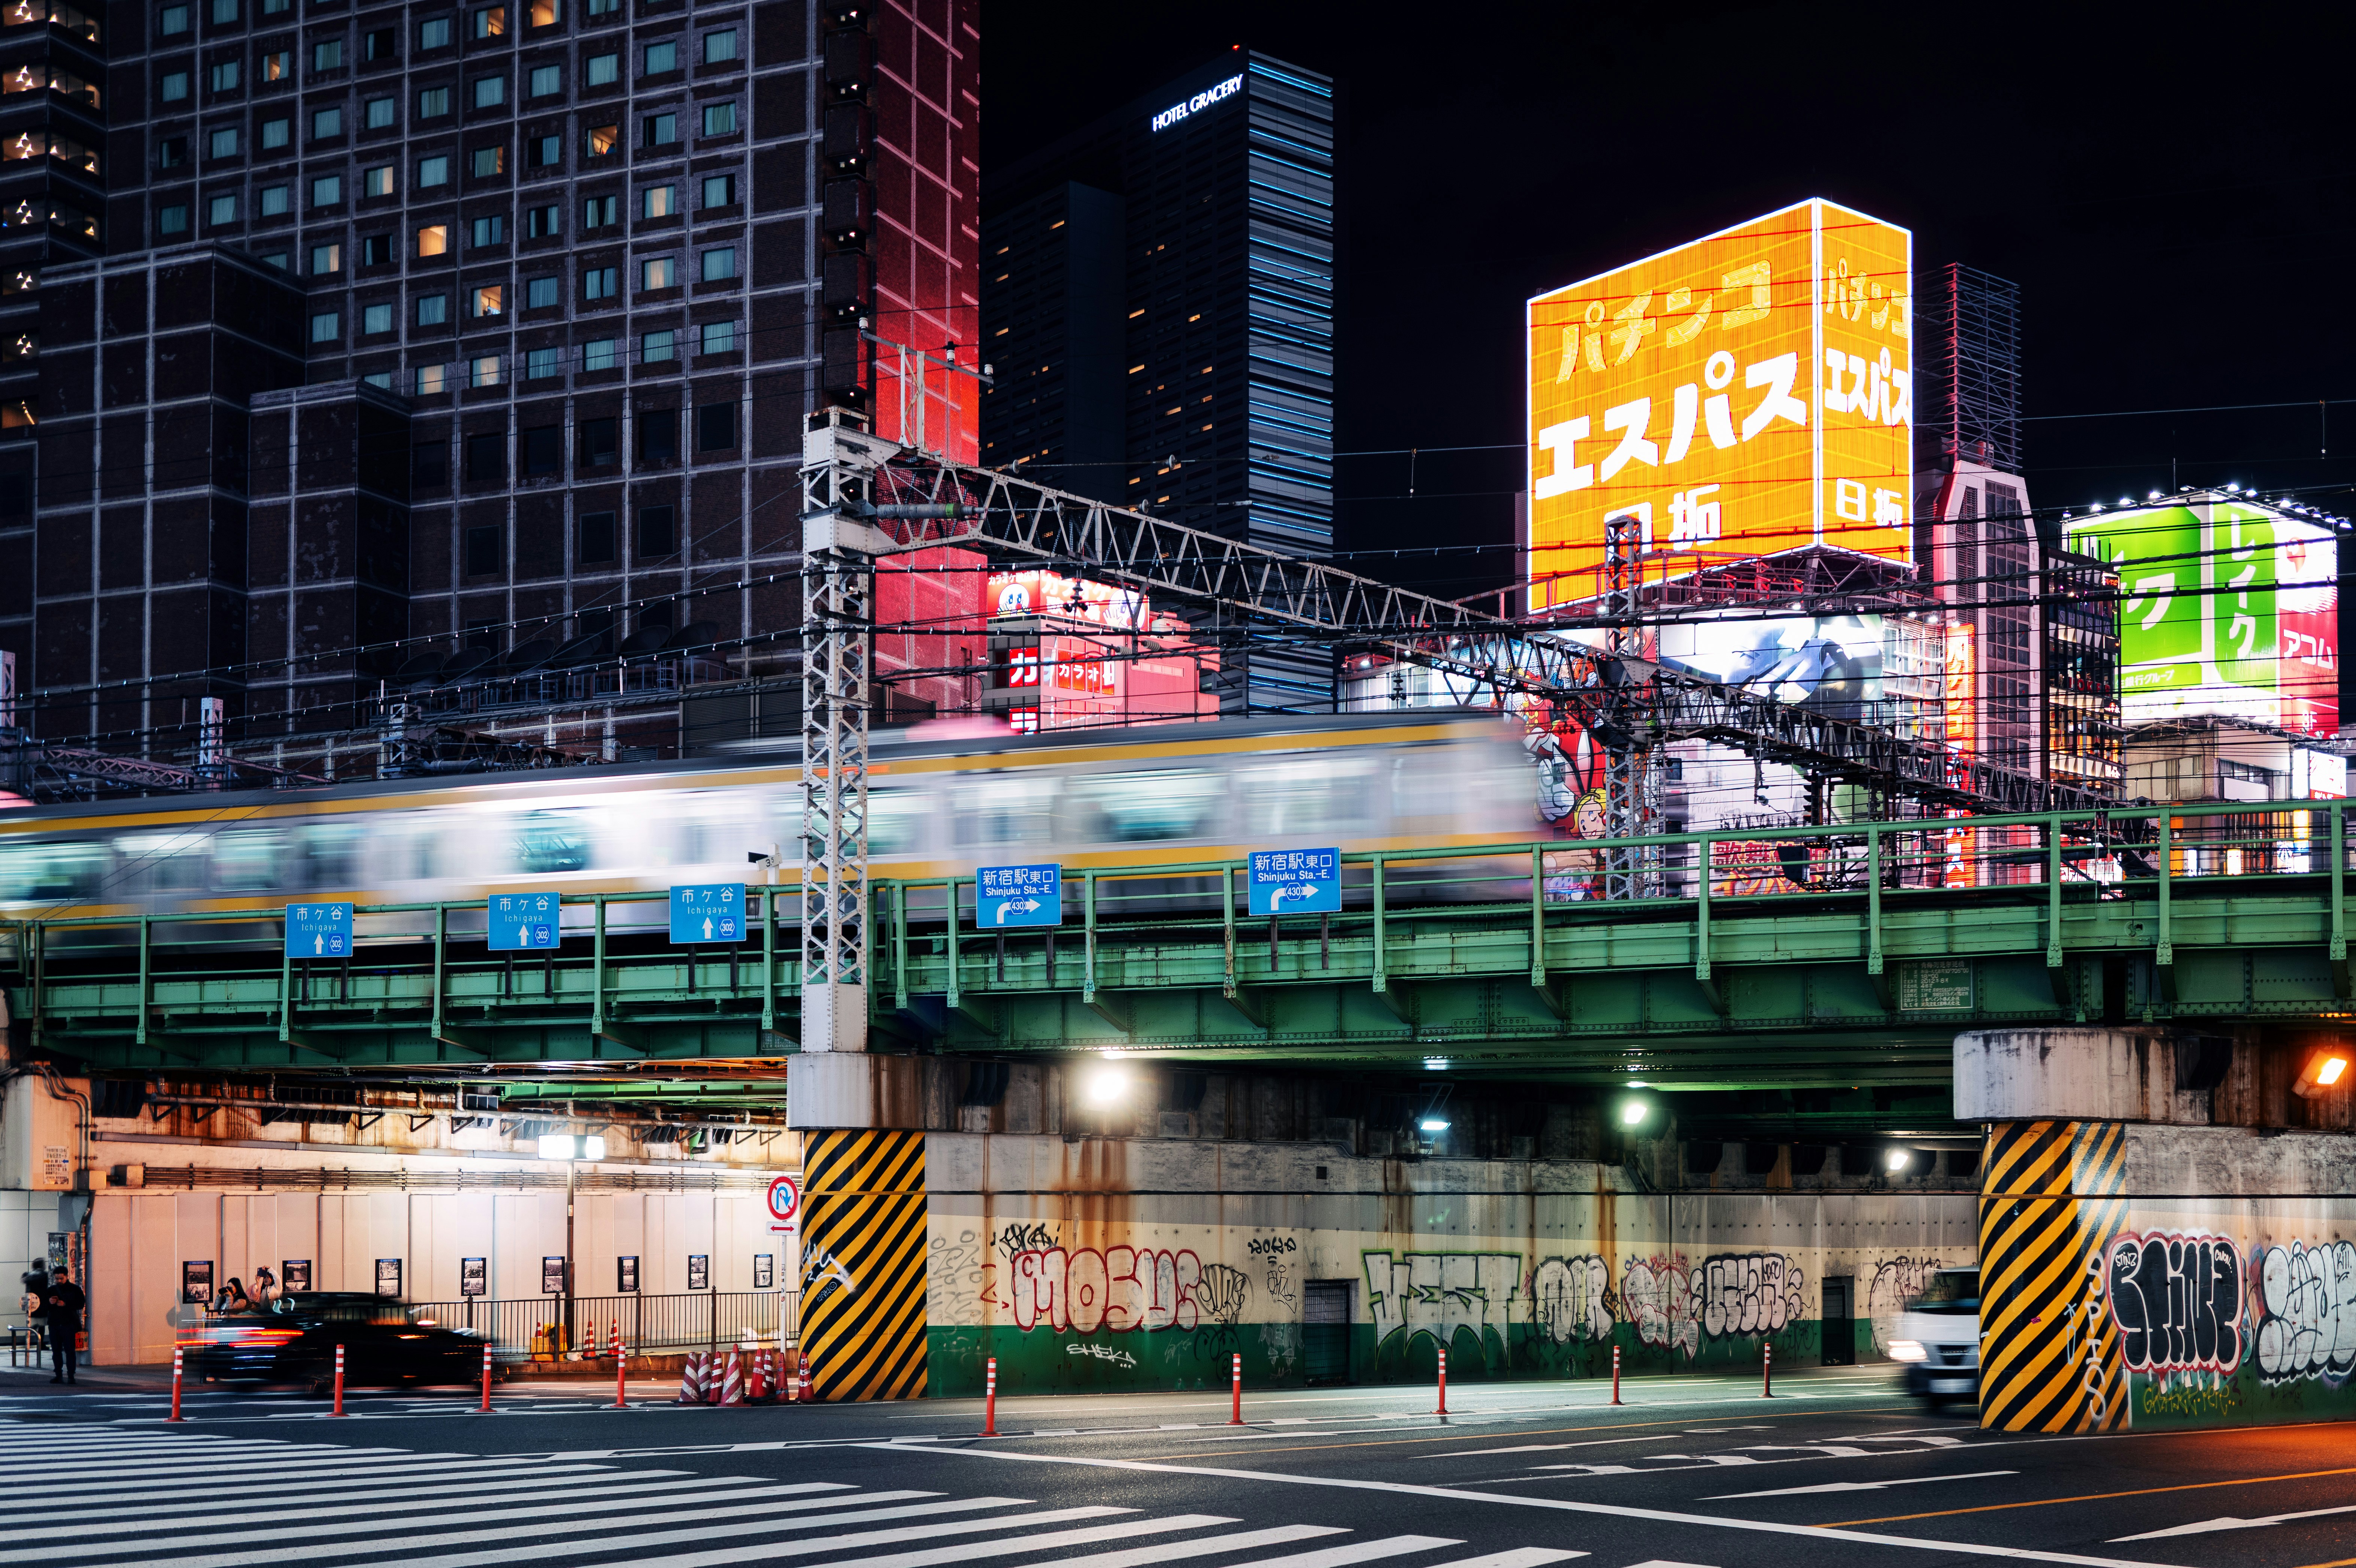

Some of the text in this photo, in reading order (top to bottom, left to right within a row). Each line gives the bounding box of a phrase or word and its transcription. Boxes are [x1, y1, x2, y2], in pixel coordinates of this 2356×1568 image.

[1152, 73, 1243, 132] HOTEL GRACERY
[1825, 257, 1908, 339] パチンコ
[1555, 259, 1771, 384] パチンコ
[1825, 346, 1909, 427] エスパス
[1535, 349, 1807, 500] エスパス
[2229, 513, 2257, 659] レイク
[2059, 610, 2111, 634] SHISHA
[2283, 629, 2334, 670] アコム
[1255, 853, 1332, 871] 新宿駅東口
[982, 868, 1053, 885] 新宿駅東口
[1258, 870, 1330, 883] Shinjuku Sta.-E.
[986, 885, 1052, 898] Shinjuku Sta.-E.
[1287, 887, 1300, 896] 430
[688, 906, 728, 915] Ichigaya
[1011, 901, 1025, 911] 430
[505, 914, 543, 923] Ichigaya
[301, 923, 337, 932] Ichigaya
[537, 931, 548, 939] 302
[722, 923, 733, 932] 302
[331, 940, 341, 948] 302
